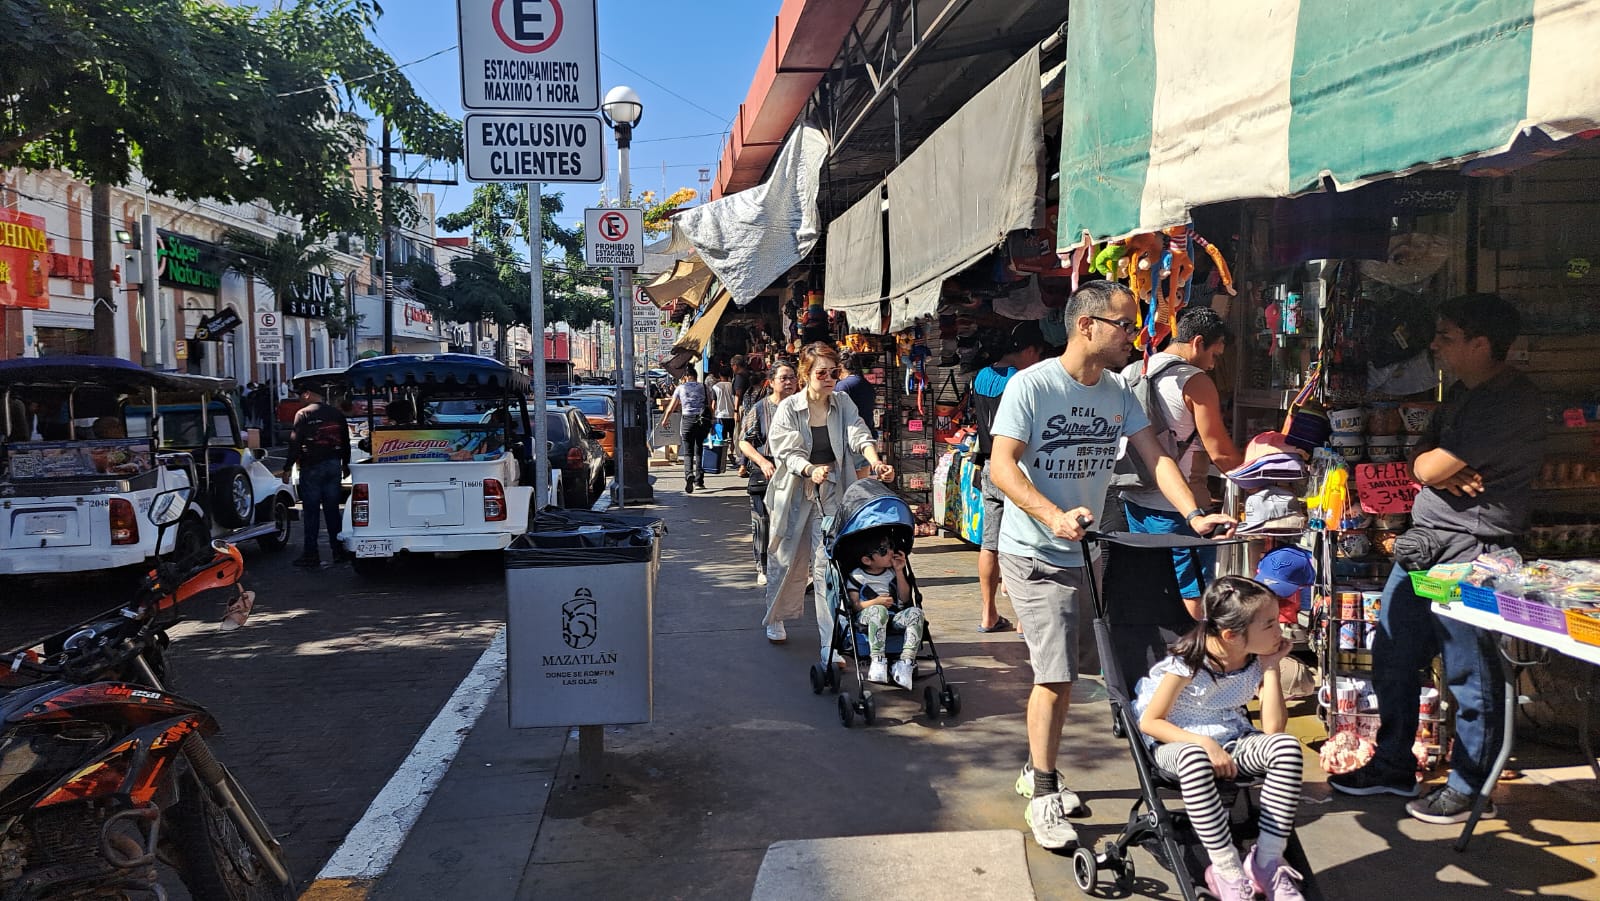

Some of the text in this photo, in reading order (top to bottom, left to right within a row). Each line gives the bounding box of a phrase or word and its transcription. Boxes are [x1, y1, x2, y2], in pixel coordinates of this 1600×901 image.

[513, 0, 544, 40] E
[484, 59, 579, 82] ESTACIONAMIENTO
[484, 83, 579, 103] MAXIMO 1 HORA
[482, 122, 587, 147] EXCLUSIVO
[490, 151, 582, 175] CLIENTES
[1071, 407, 1096, 417] REAL
[1033, 458, 1114, 471] AUTHENTIC
[1364, 464, 1406, 479] OFER
